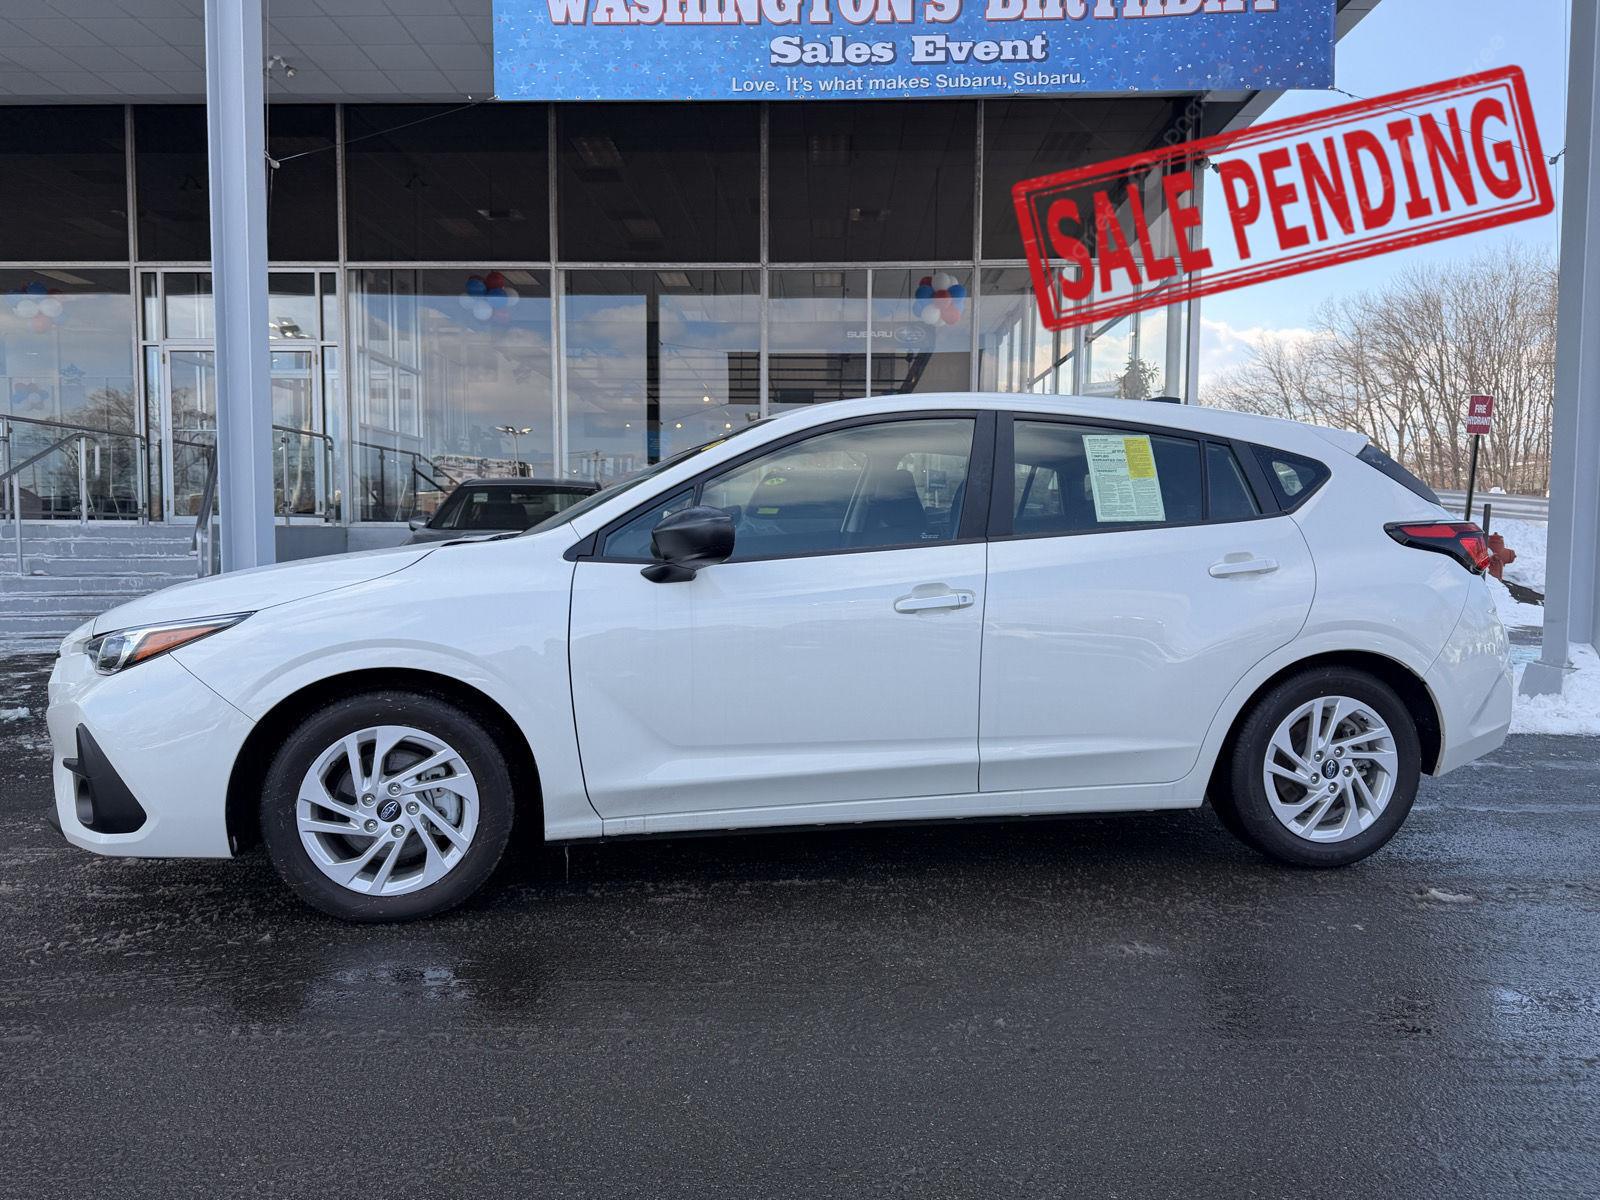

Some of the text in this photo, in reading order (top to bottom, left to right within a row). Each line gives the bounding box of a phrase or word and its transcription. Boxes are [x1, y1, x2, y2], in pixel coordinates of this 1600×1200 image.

[769, 33, 1048, 65] Sales Event
[731, 71, 1087, 92] Love. It's what makes Subaru, Subaru.
[1475, 404, 1487, 413] FIRE
